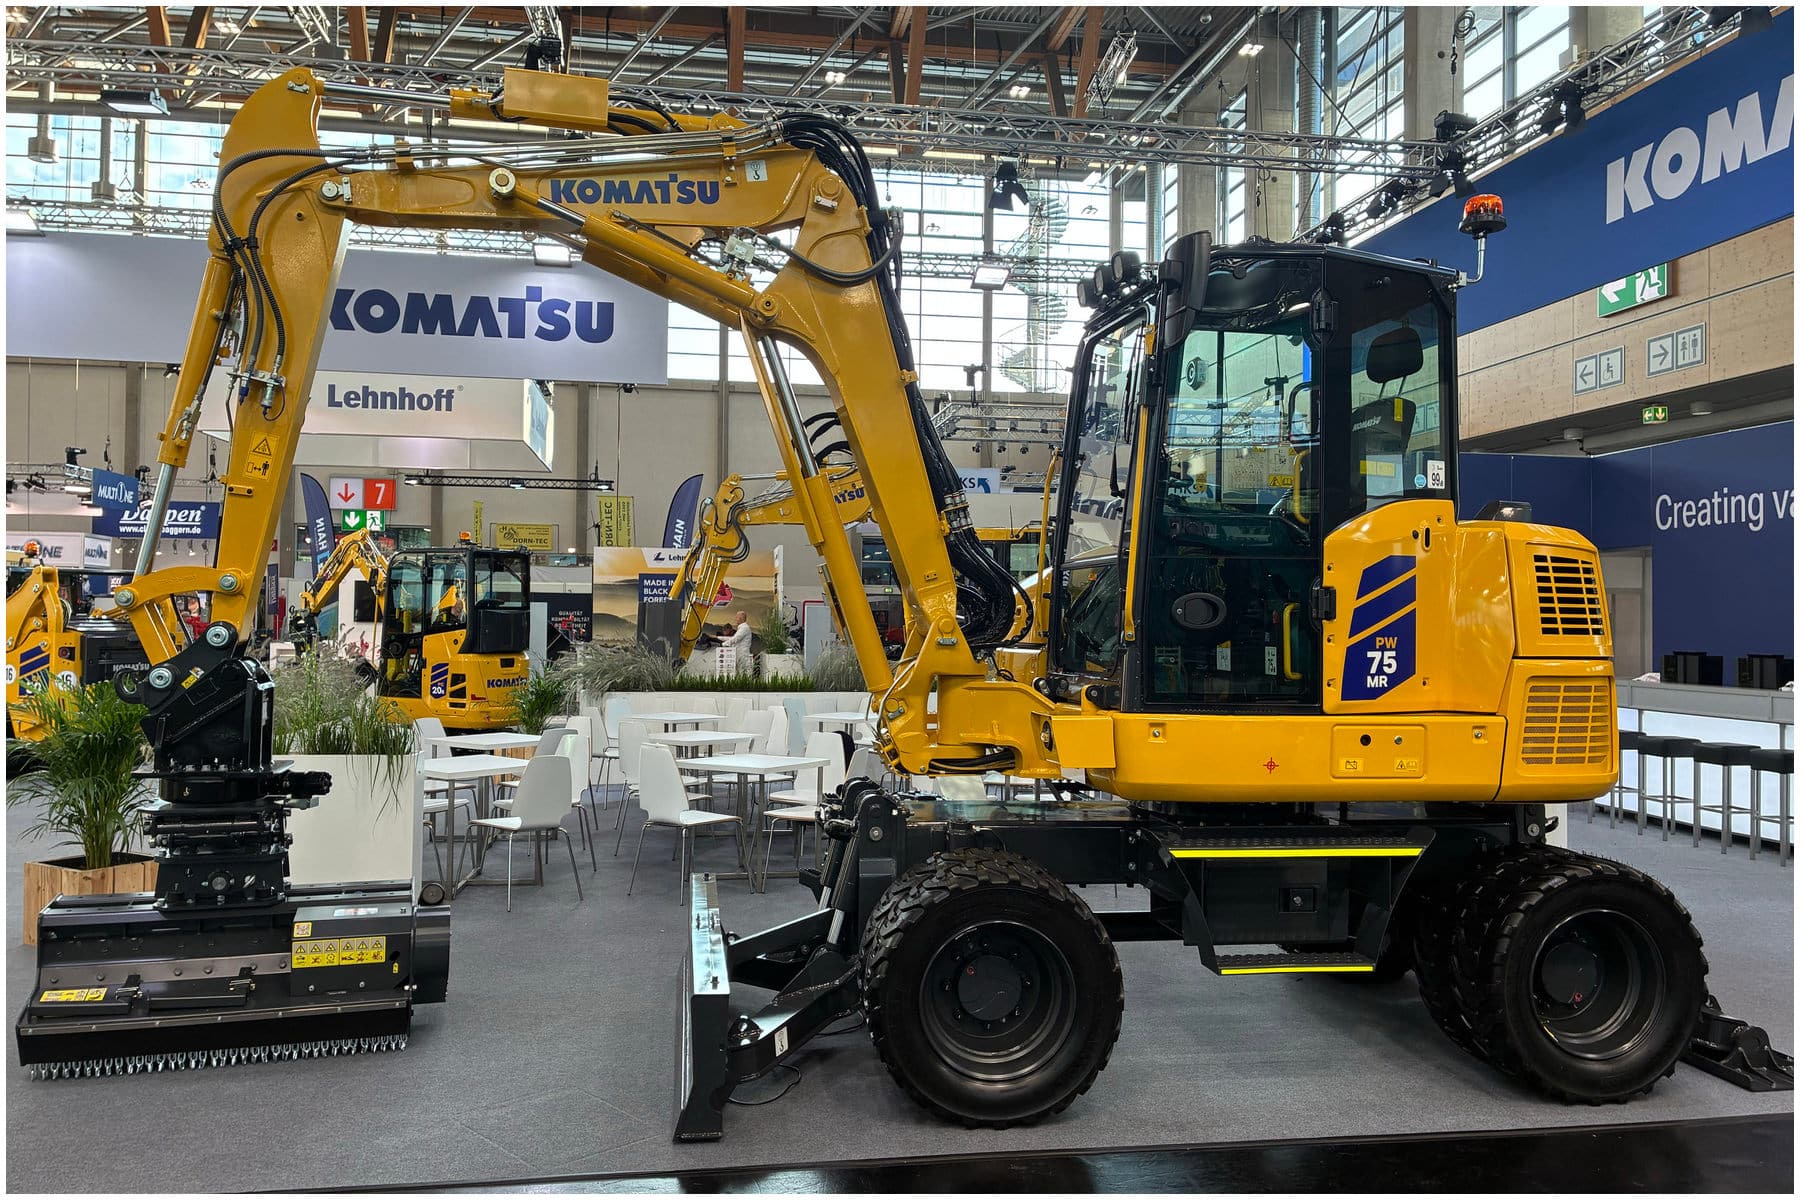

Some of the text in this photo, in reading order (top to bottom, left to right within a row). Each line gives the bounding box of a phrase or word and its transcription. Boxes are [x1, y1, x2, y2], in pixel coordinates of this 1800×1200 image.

[550, 173, 720, 205] KOMATSU
[329, 285, 615, 344] KOMATSU
[327, 383, 455, 412] Lehnhoff
[375, 483, 386, 505] 7
[834, 488, 865, 504] ATSU
[1655, 487, 1764, 532] Creating
[1375, 636, 1398, 649] PW
[1366, 650, 1398, 674] 75
[1366, 675, 1388, 688] MR
